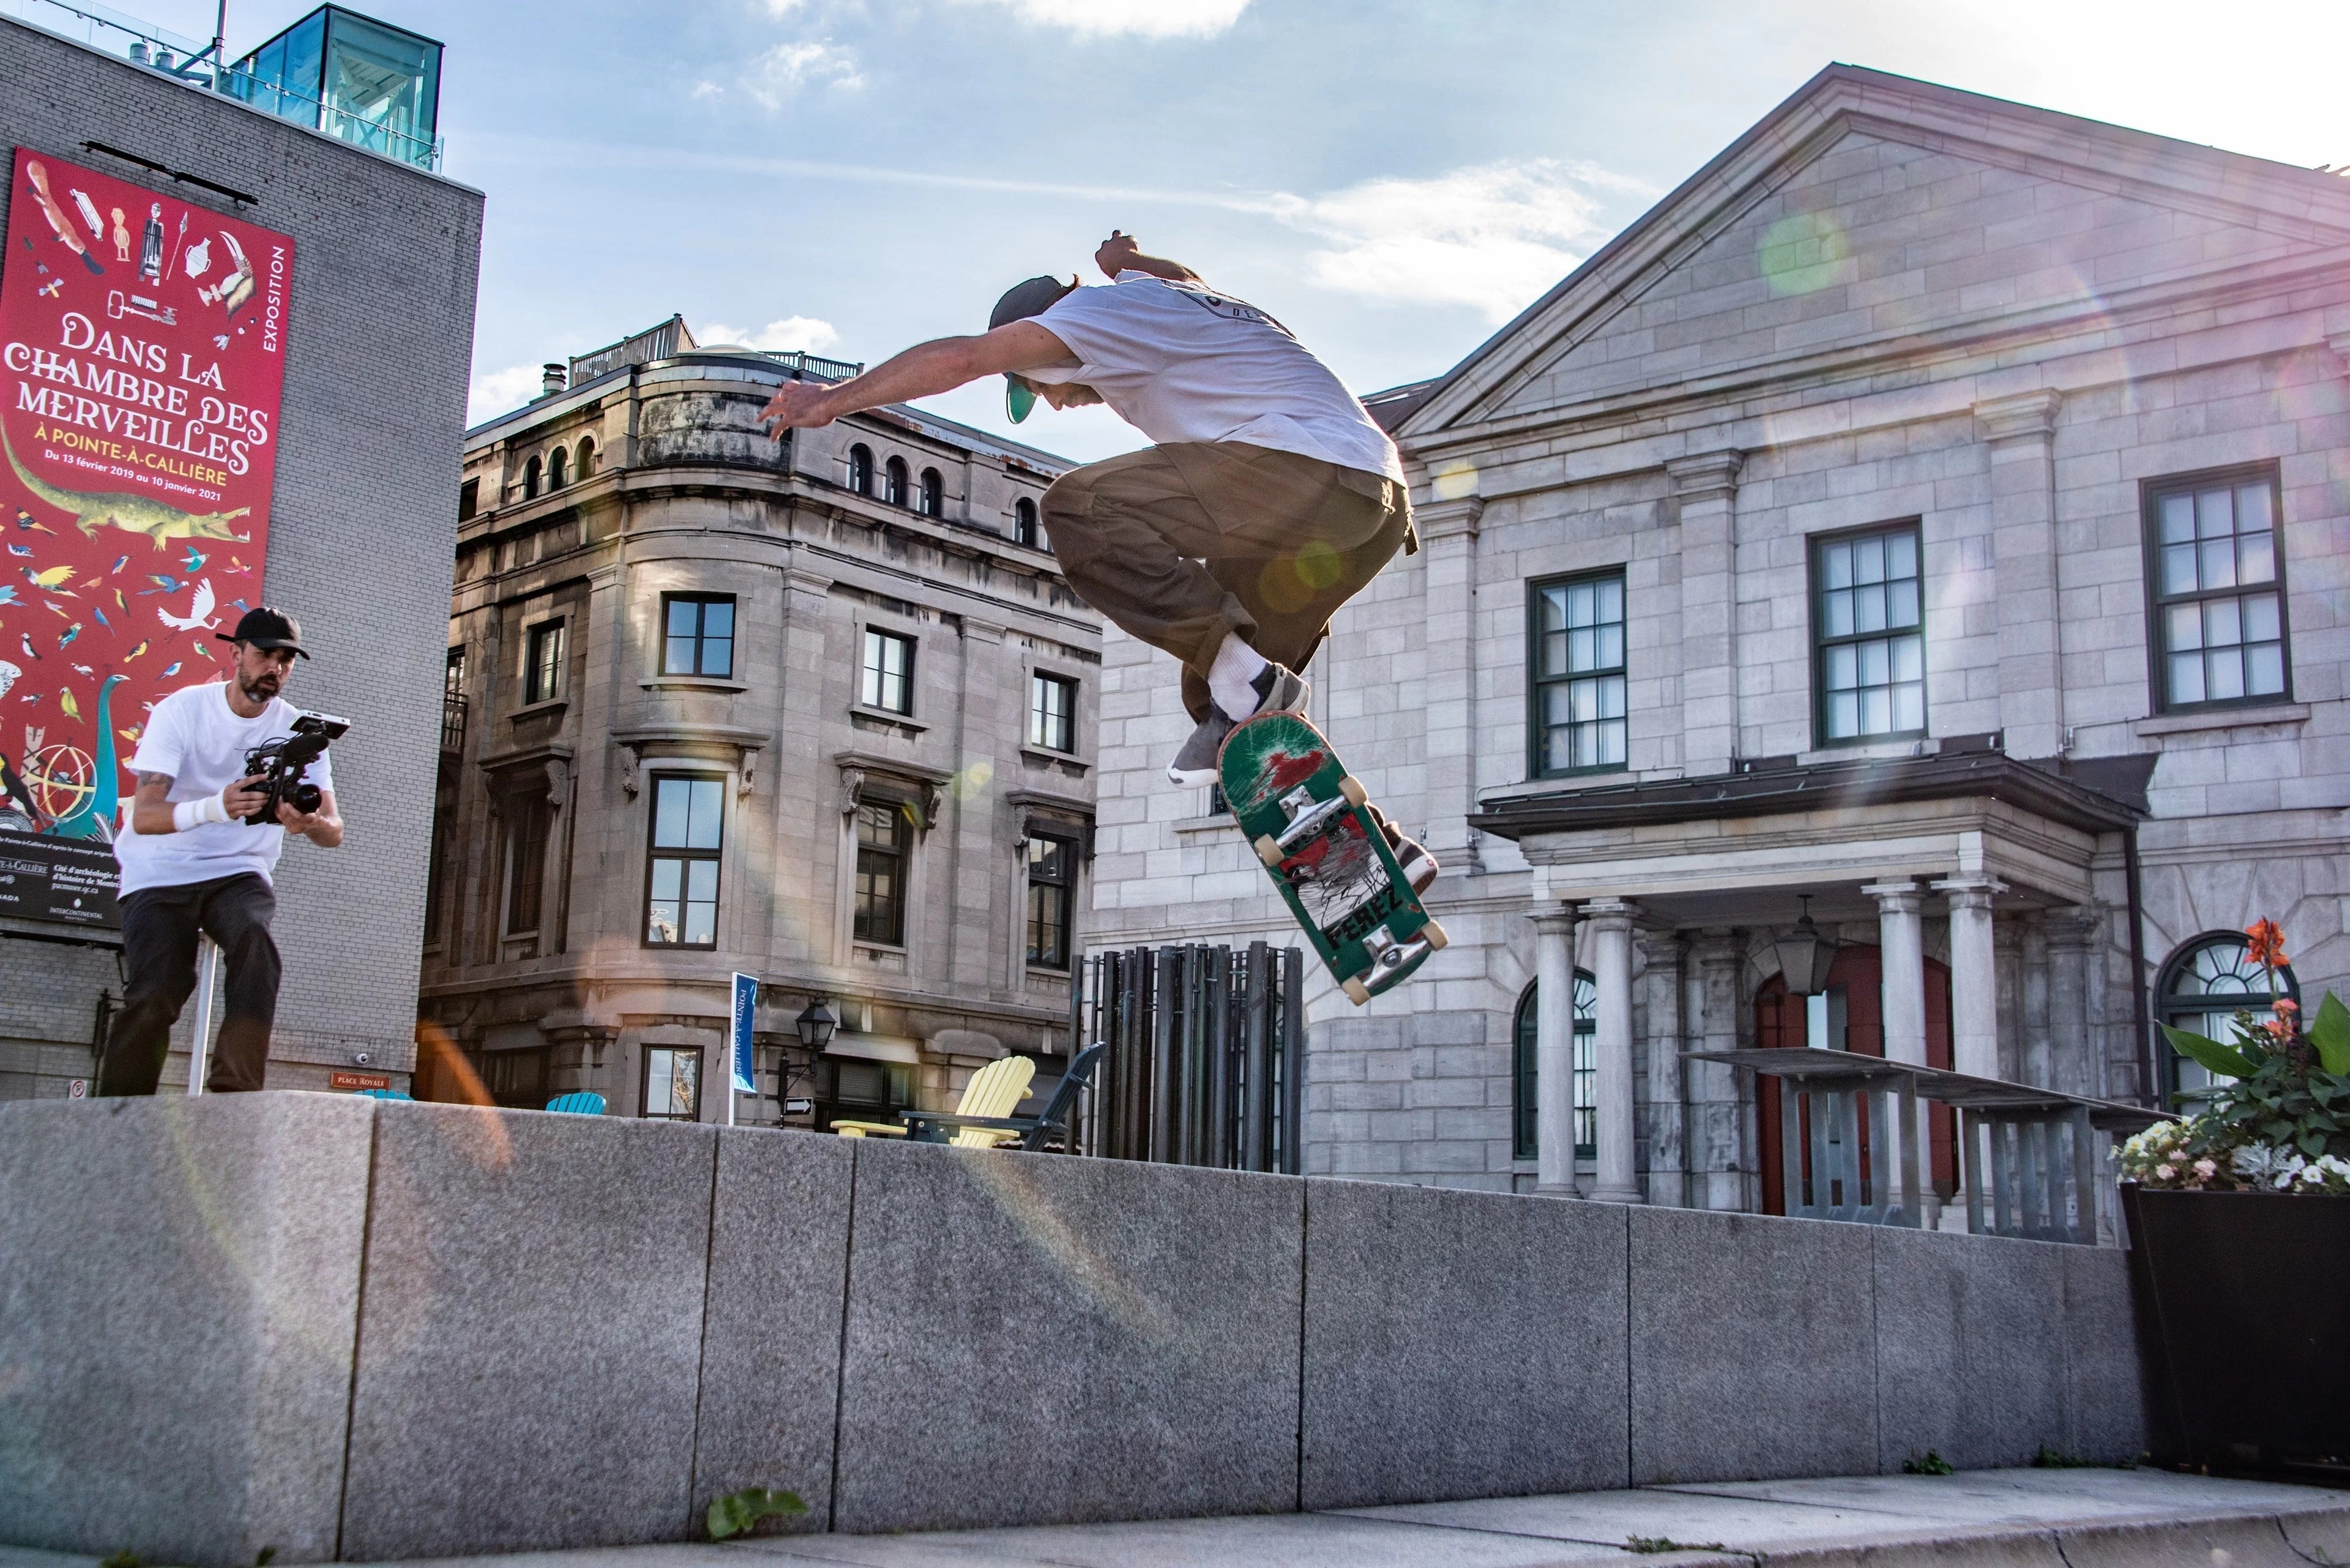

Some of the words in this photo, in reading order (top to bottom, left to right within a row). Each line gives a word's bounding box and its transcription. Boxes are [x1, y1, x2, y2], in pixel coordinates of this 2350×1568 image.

[263, 246, 285, 353] EXPOSITION
[60, 312, 166, 373] DANS
[179, 353, 226, 391] LA
[4, 342, 188, 416] CHAMBRE
[199, 397, 268, 446] DES
[15, 381, 250, 476] MERVEILLES
[34, 422, 47, 441] À
[53, 428, 227, 487] POINTE-À-CALLIÈRE
[45, 449, 59, 460] Du
[62, 454, 74, 464] 13
[76, 457, 108, 472] février
[110, 466, 134, 479] 2019
[136, 474, 149, 483] au
[152, 477, 163, 487] 10
[164, 480, 196, 496] janvier
[198, 489, 221, 501] 2021
[1322, 884, 1403, 950] PEREZ
[359, 1078, 384, 1086] ROYALE
